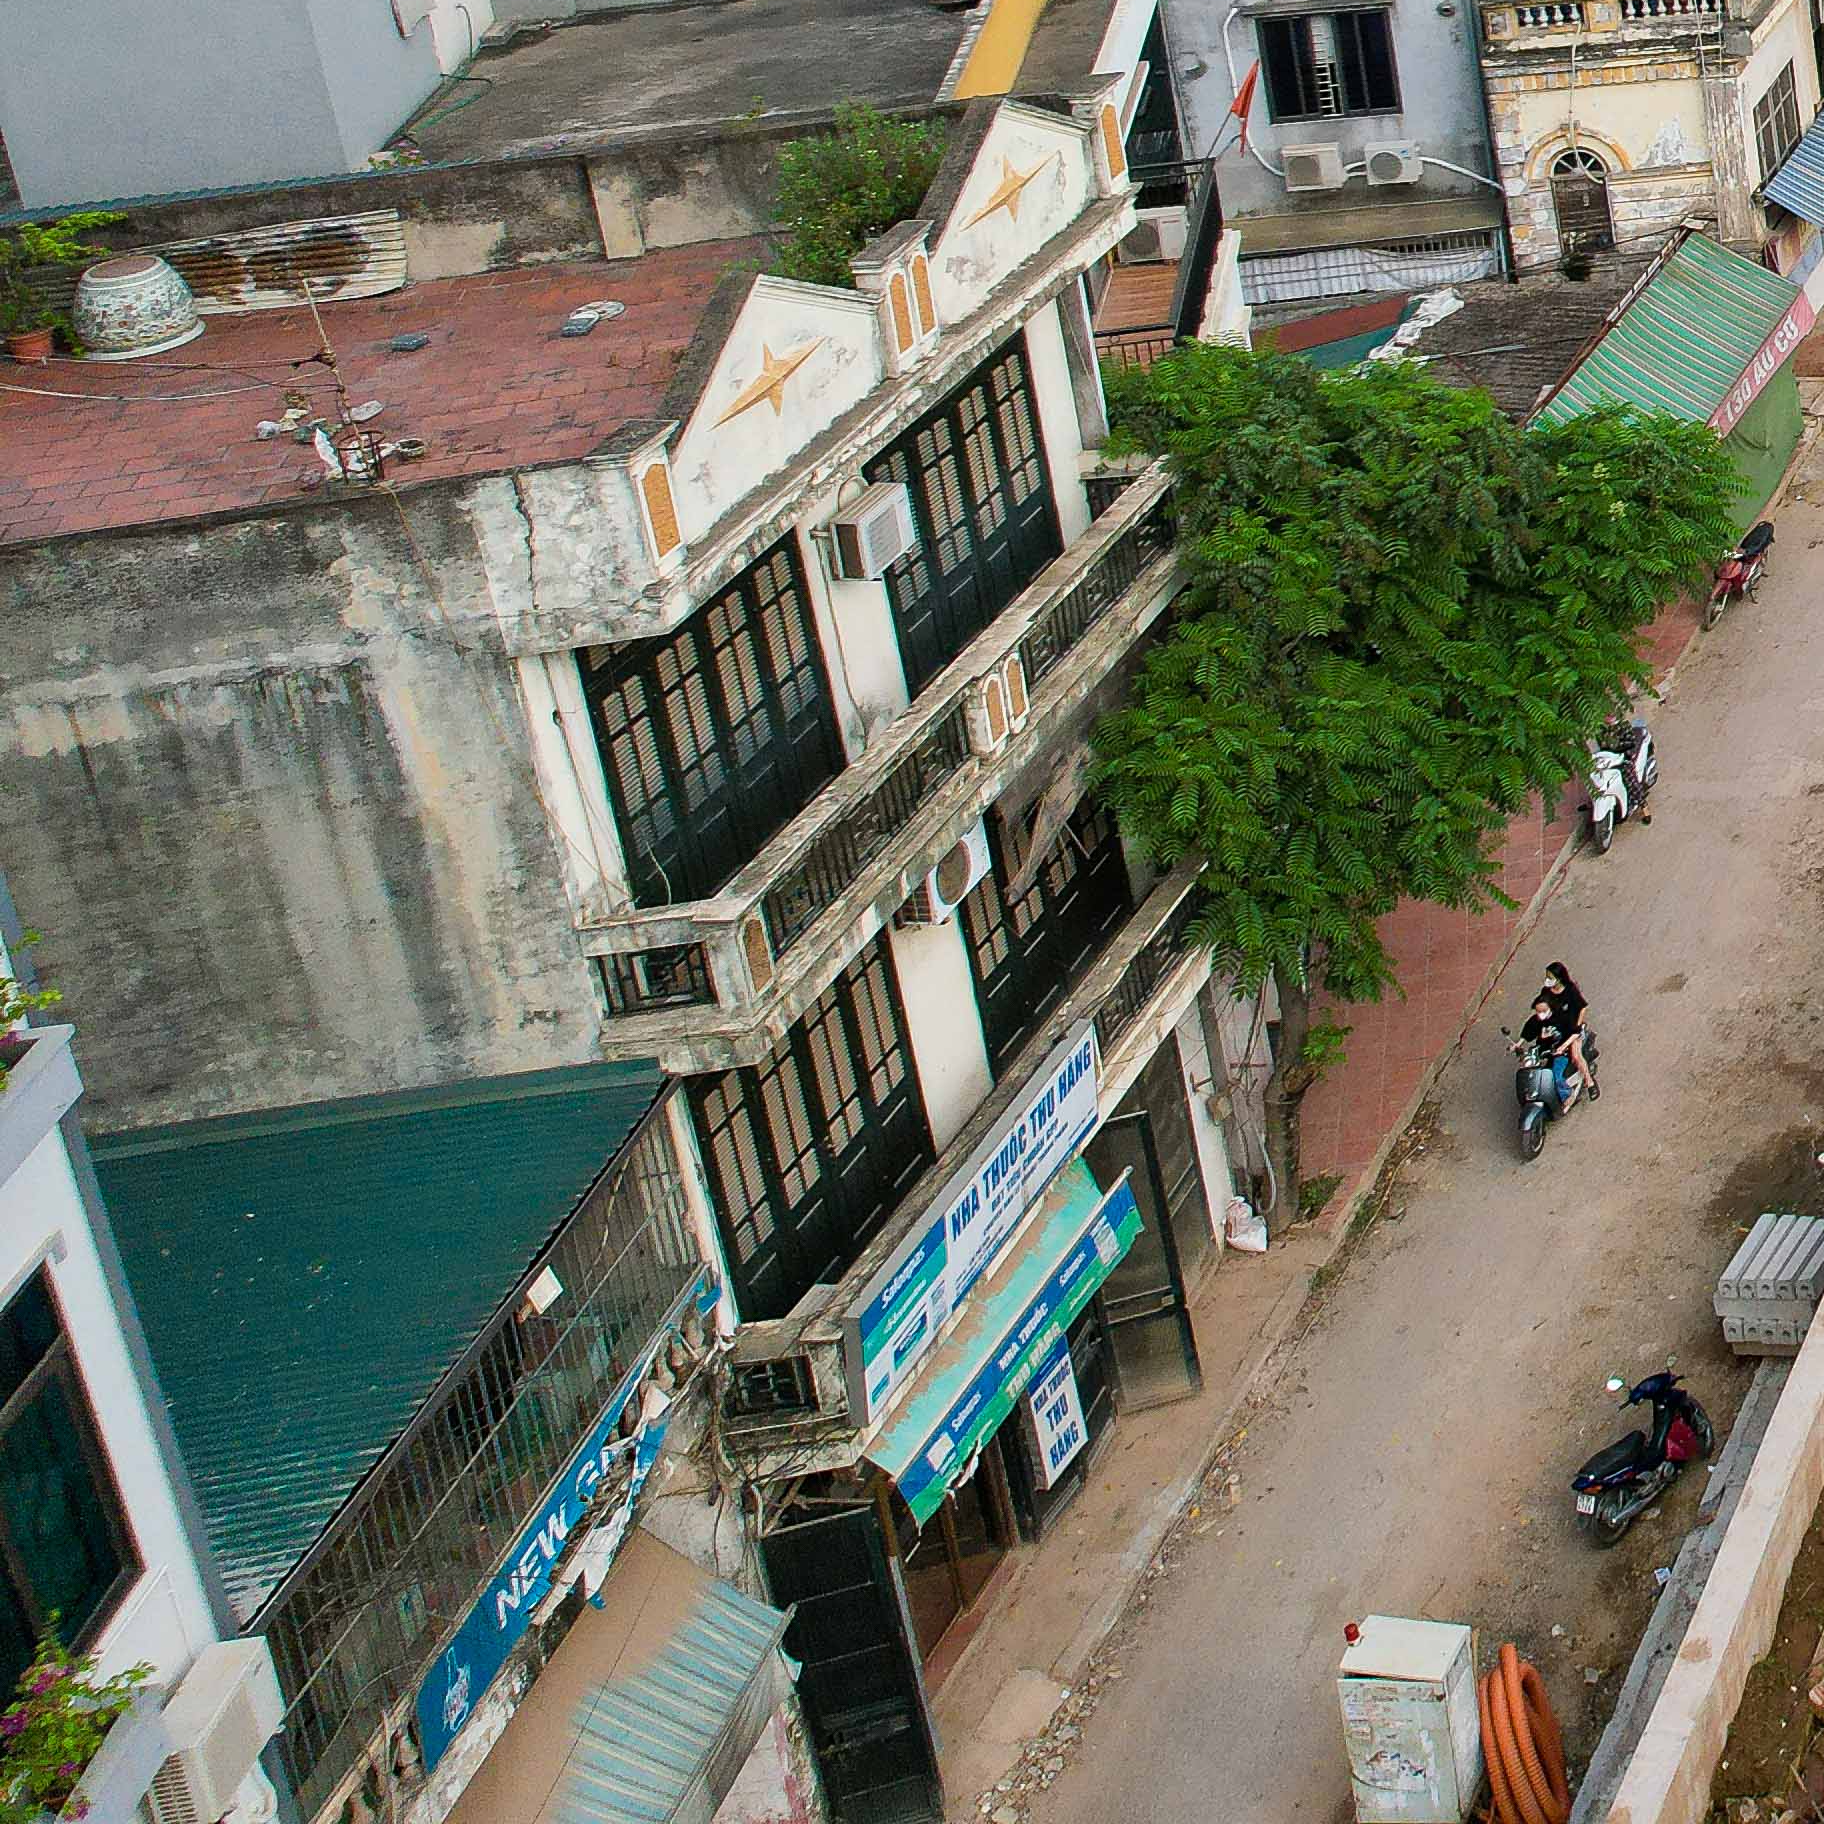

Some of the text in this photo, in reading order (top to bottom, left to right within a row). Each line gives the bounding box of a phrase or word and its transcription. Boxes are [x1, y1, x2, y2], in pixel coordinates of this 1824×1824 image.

[950, 1189, 981, 1242] NHÀ
[982, 1120, 1027, 1200] THUỐC
[1028, 1091, 1055, 1138] THU
[1046, 1391, 1069, 1432] THU
[496, 1500, 570, 1630] NEW
